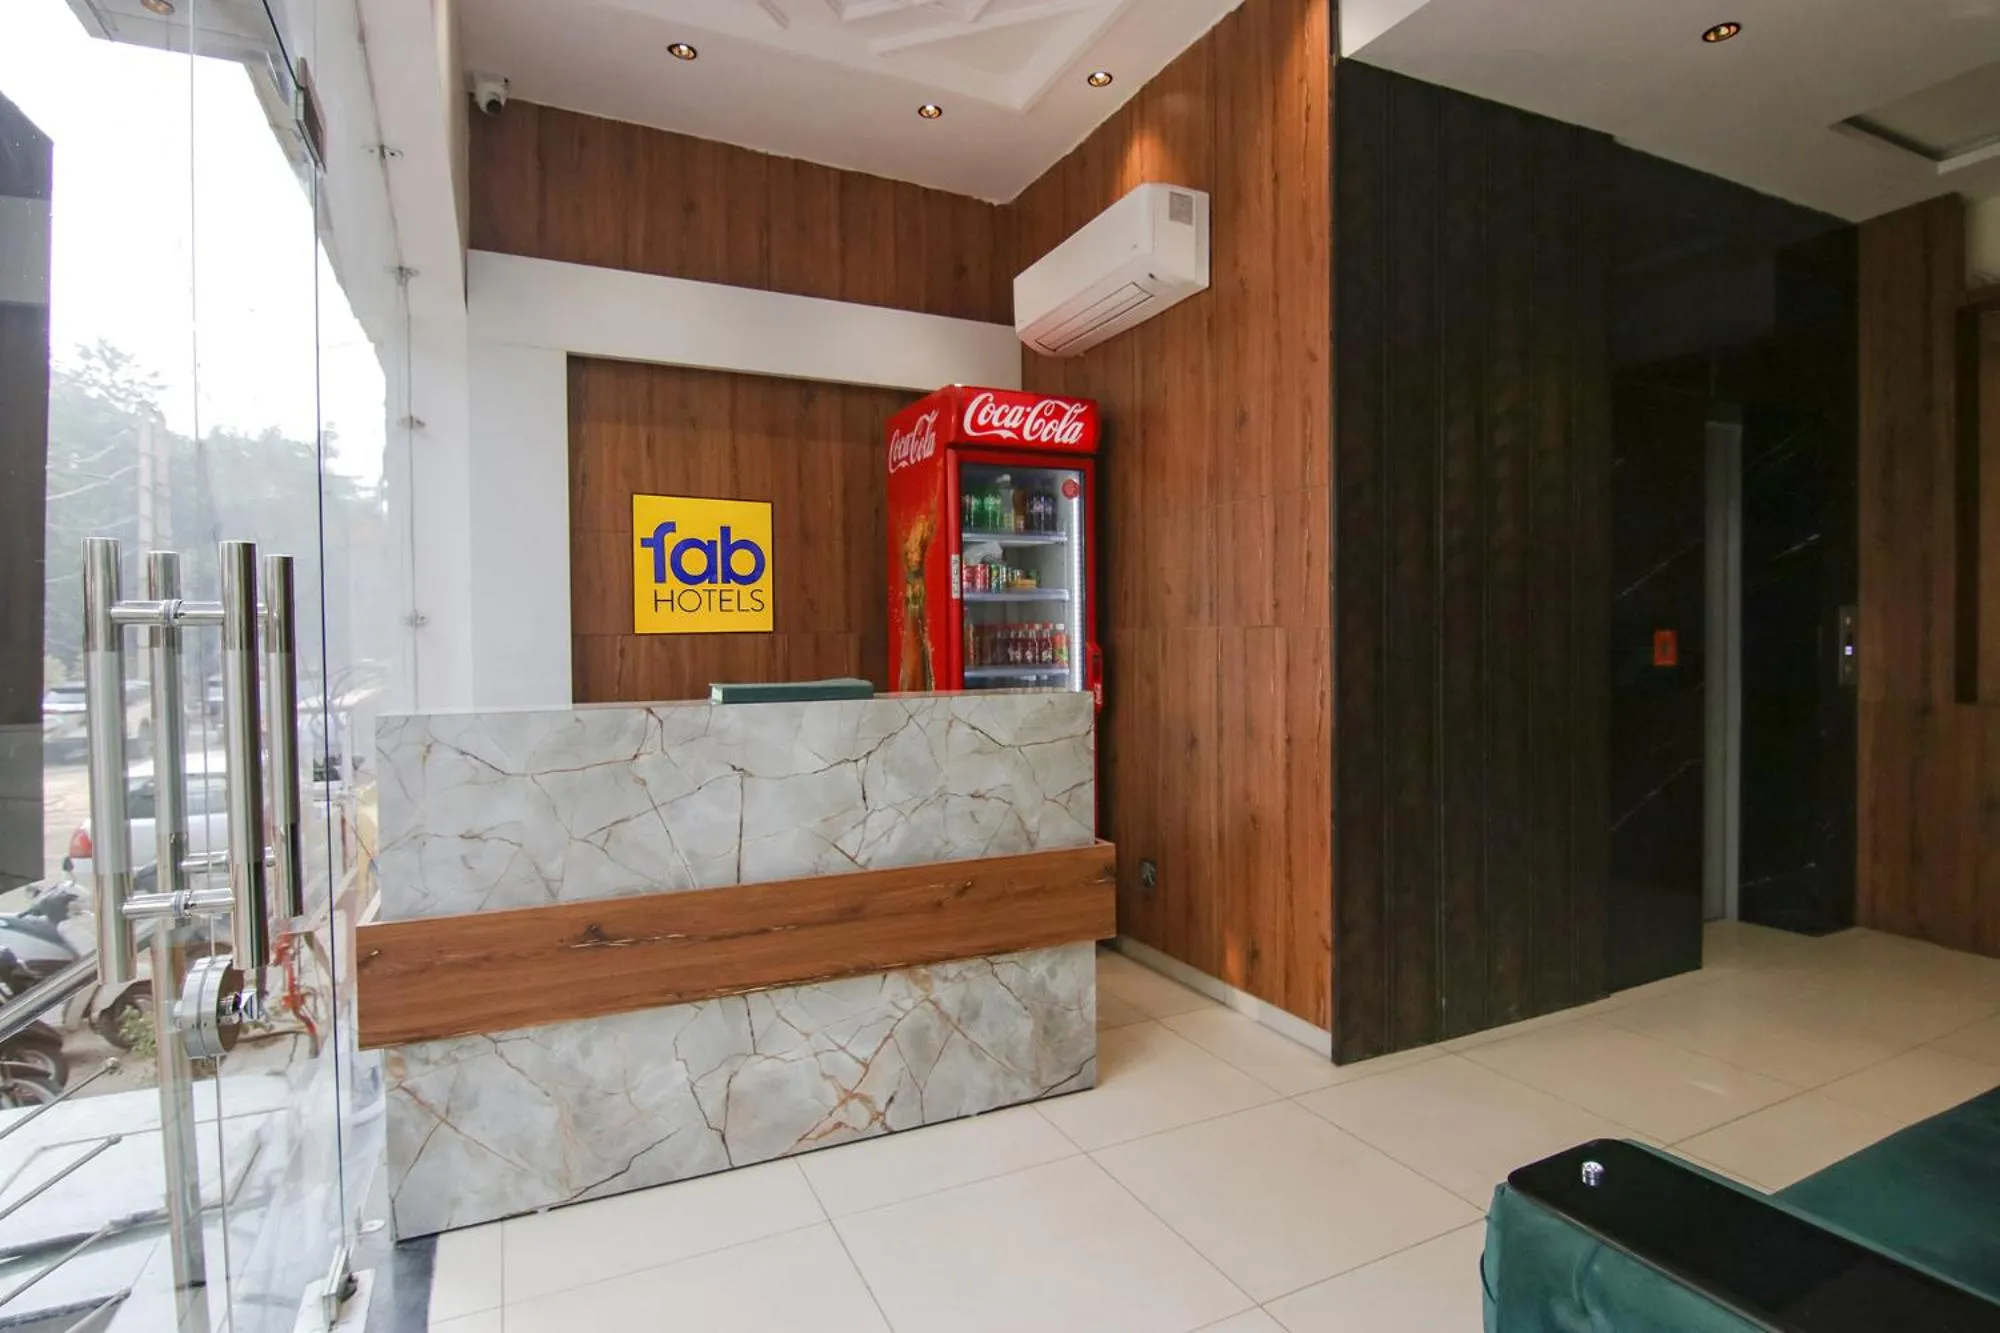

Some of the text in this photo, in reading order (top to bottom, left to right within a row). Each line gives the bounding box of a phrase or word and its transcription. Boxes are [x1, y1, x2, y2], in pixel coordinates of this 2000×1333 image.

[888, 409, 939, 474] Coca-Cola
[963, 392, 1088, 444] Coca-Cola
[640, 521, 766, 586] fab
[654, 588, 765, 613] HOTELS
